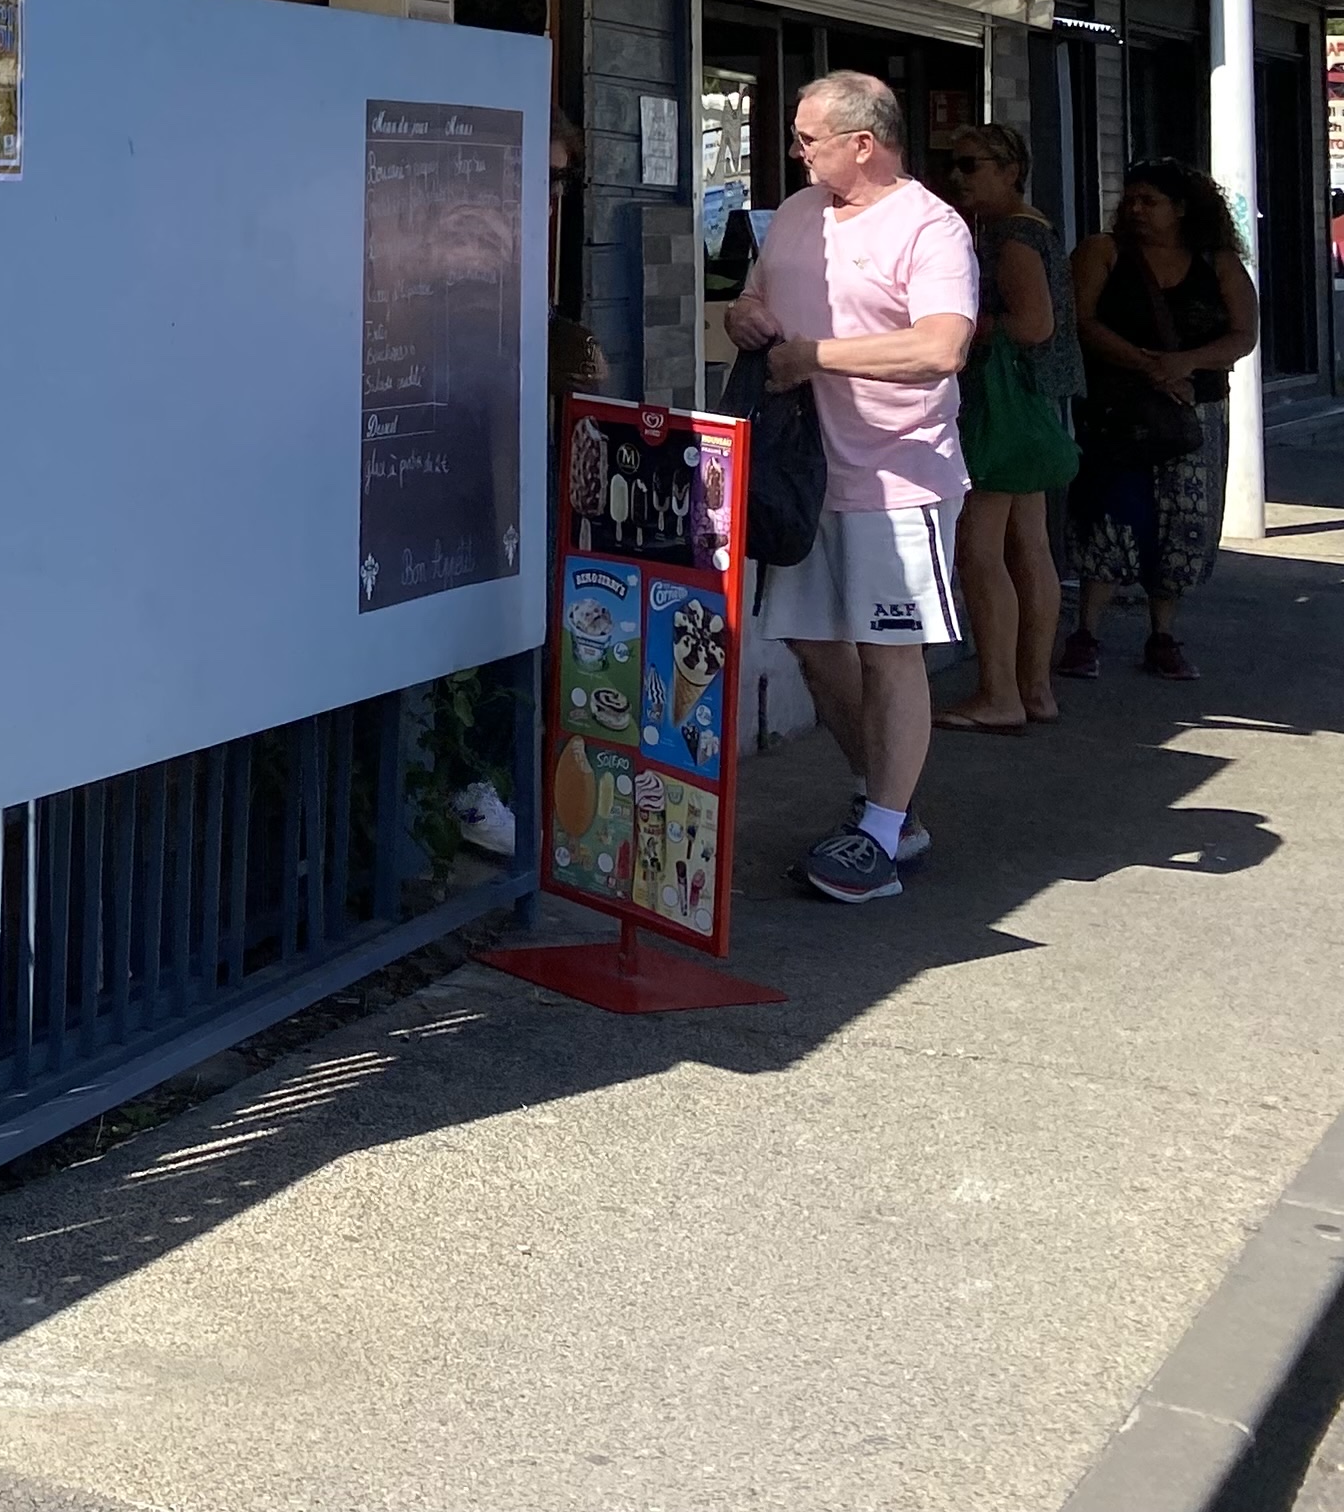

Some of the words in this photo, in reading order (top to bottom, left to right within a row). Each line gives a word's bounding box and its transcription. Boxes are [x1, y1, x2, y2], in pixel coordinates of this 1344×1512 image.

[400, 547, 427, 586] Bon
[873, 603, 916, 616] A&F
[596, 751, 630, 771] SOLERO
